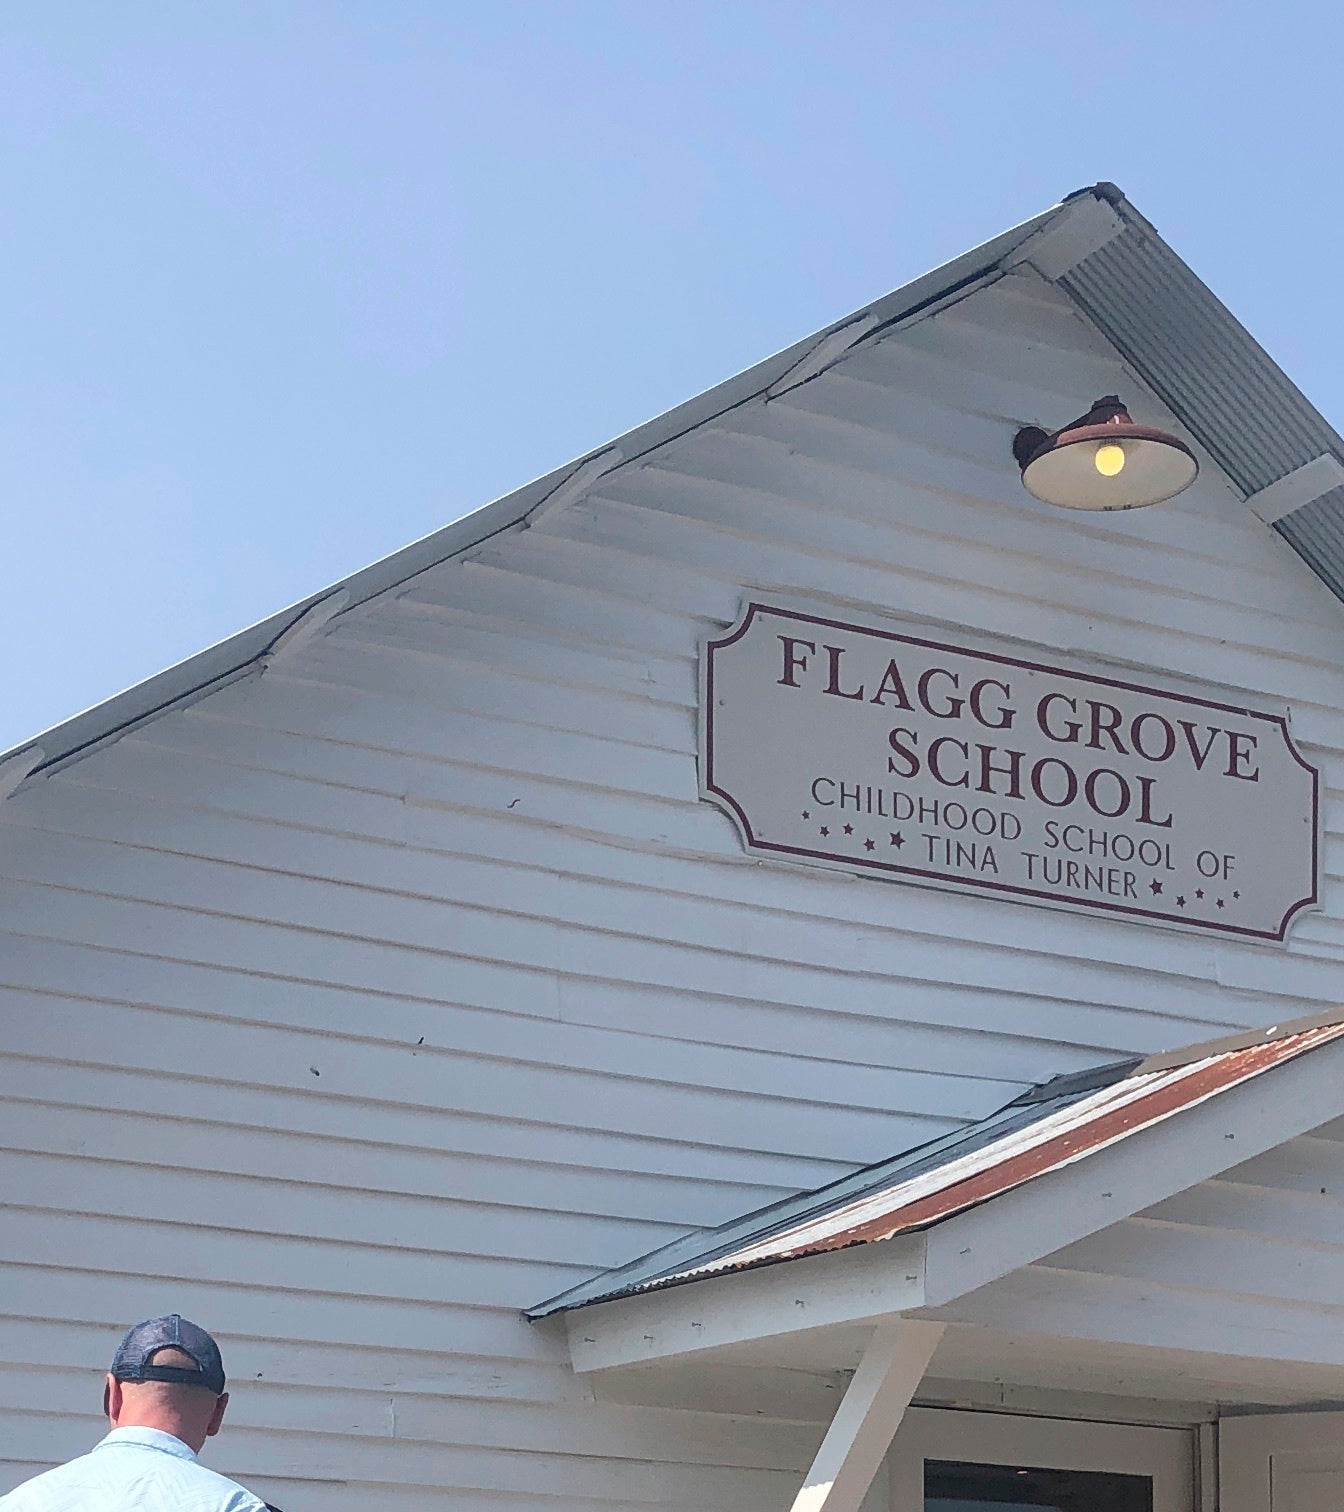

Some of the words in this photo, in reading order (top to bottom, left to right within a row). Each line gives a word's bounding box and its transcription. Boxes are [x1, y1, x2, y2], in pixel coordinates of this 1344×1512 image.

[776, 635, 1017, 730] FLAGG
[1036, 693, 1260, 782] GROVE
[811, 777, 1022, 841] CHILDHOOD
[1044, 821, 1175, 871] SCHOOL
[1196, 851, 1236, 880] OF
[887, 728, 1173, 828] SCHOOL
[922, 834, 999, 874] TINA
[1022, 852, 1137, 898] TURNER
